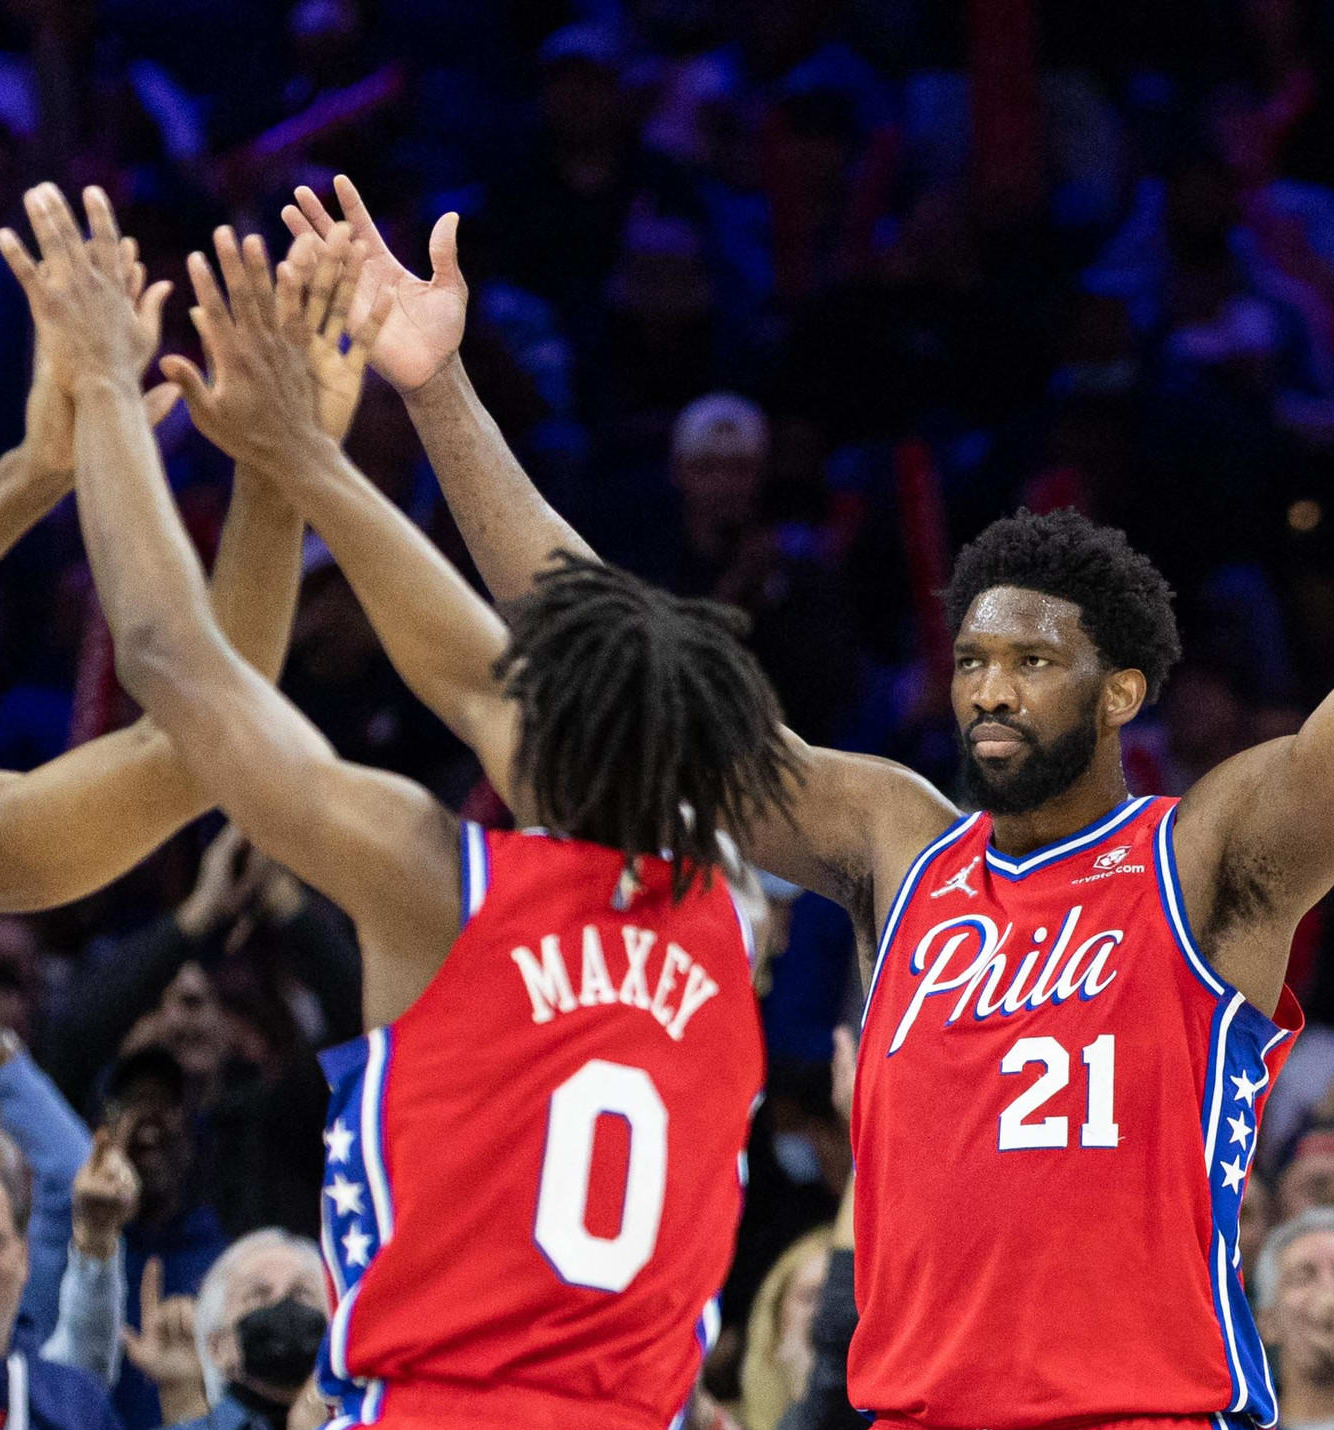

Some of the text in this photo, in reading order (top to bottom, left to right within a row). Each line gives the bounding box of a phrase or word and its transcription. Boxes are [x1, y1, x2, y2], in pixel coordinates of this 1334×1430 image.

[1071, 864, 1145, 885] crypto.com
[510, 923, 719, 1042] MAXEY
[886, 905, 1124, 1058] Phila
[997, 1034, 1120, 1153] 21
[531, 1057, 670, 1294] 0
